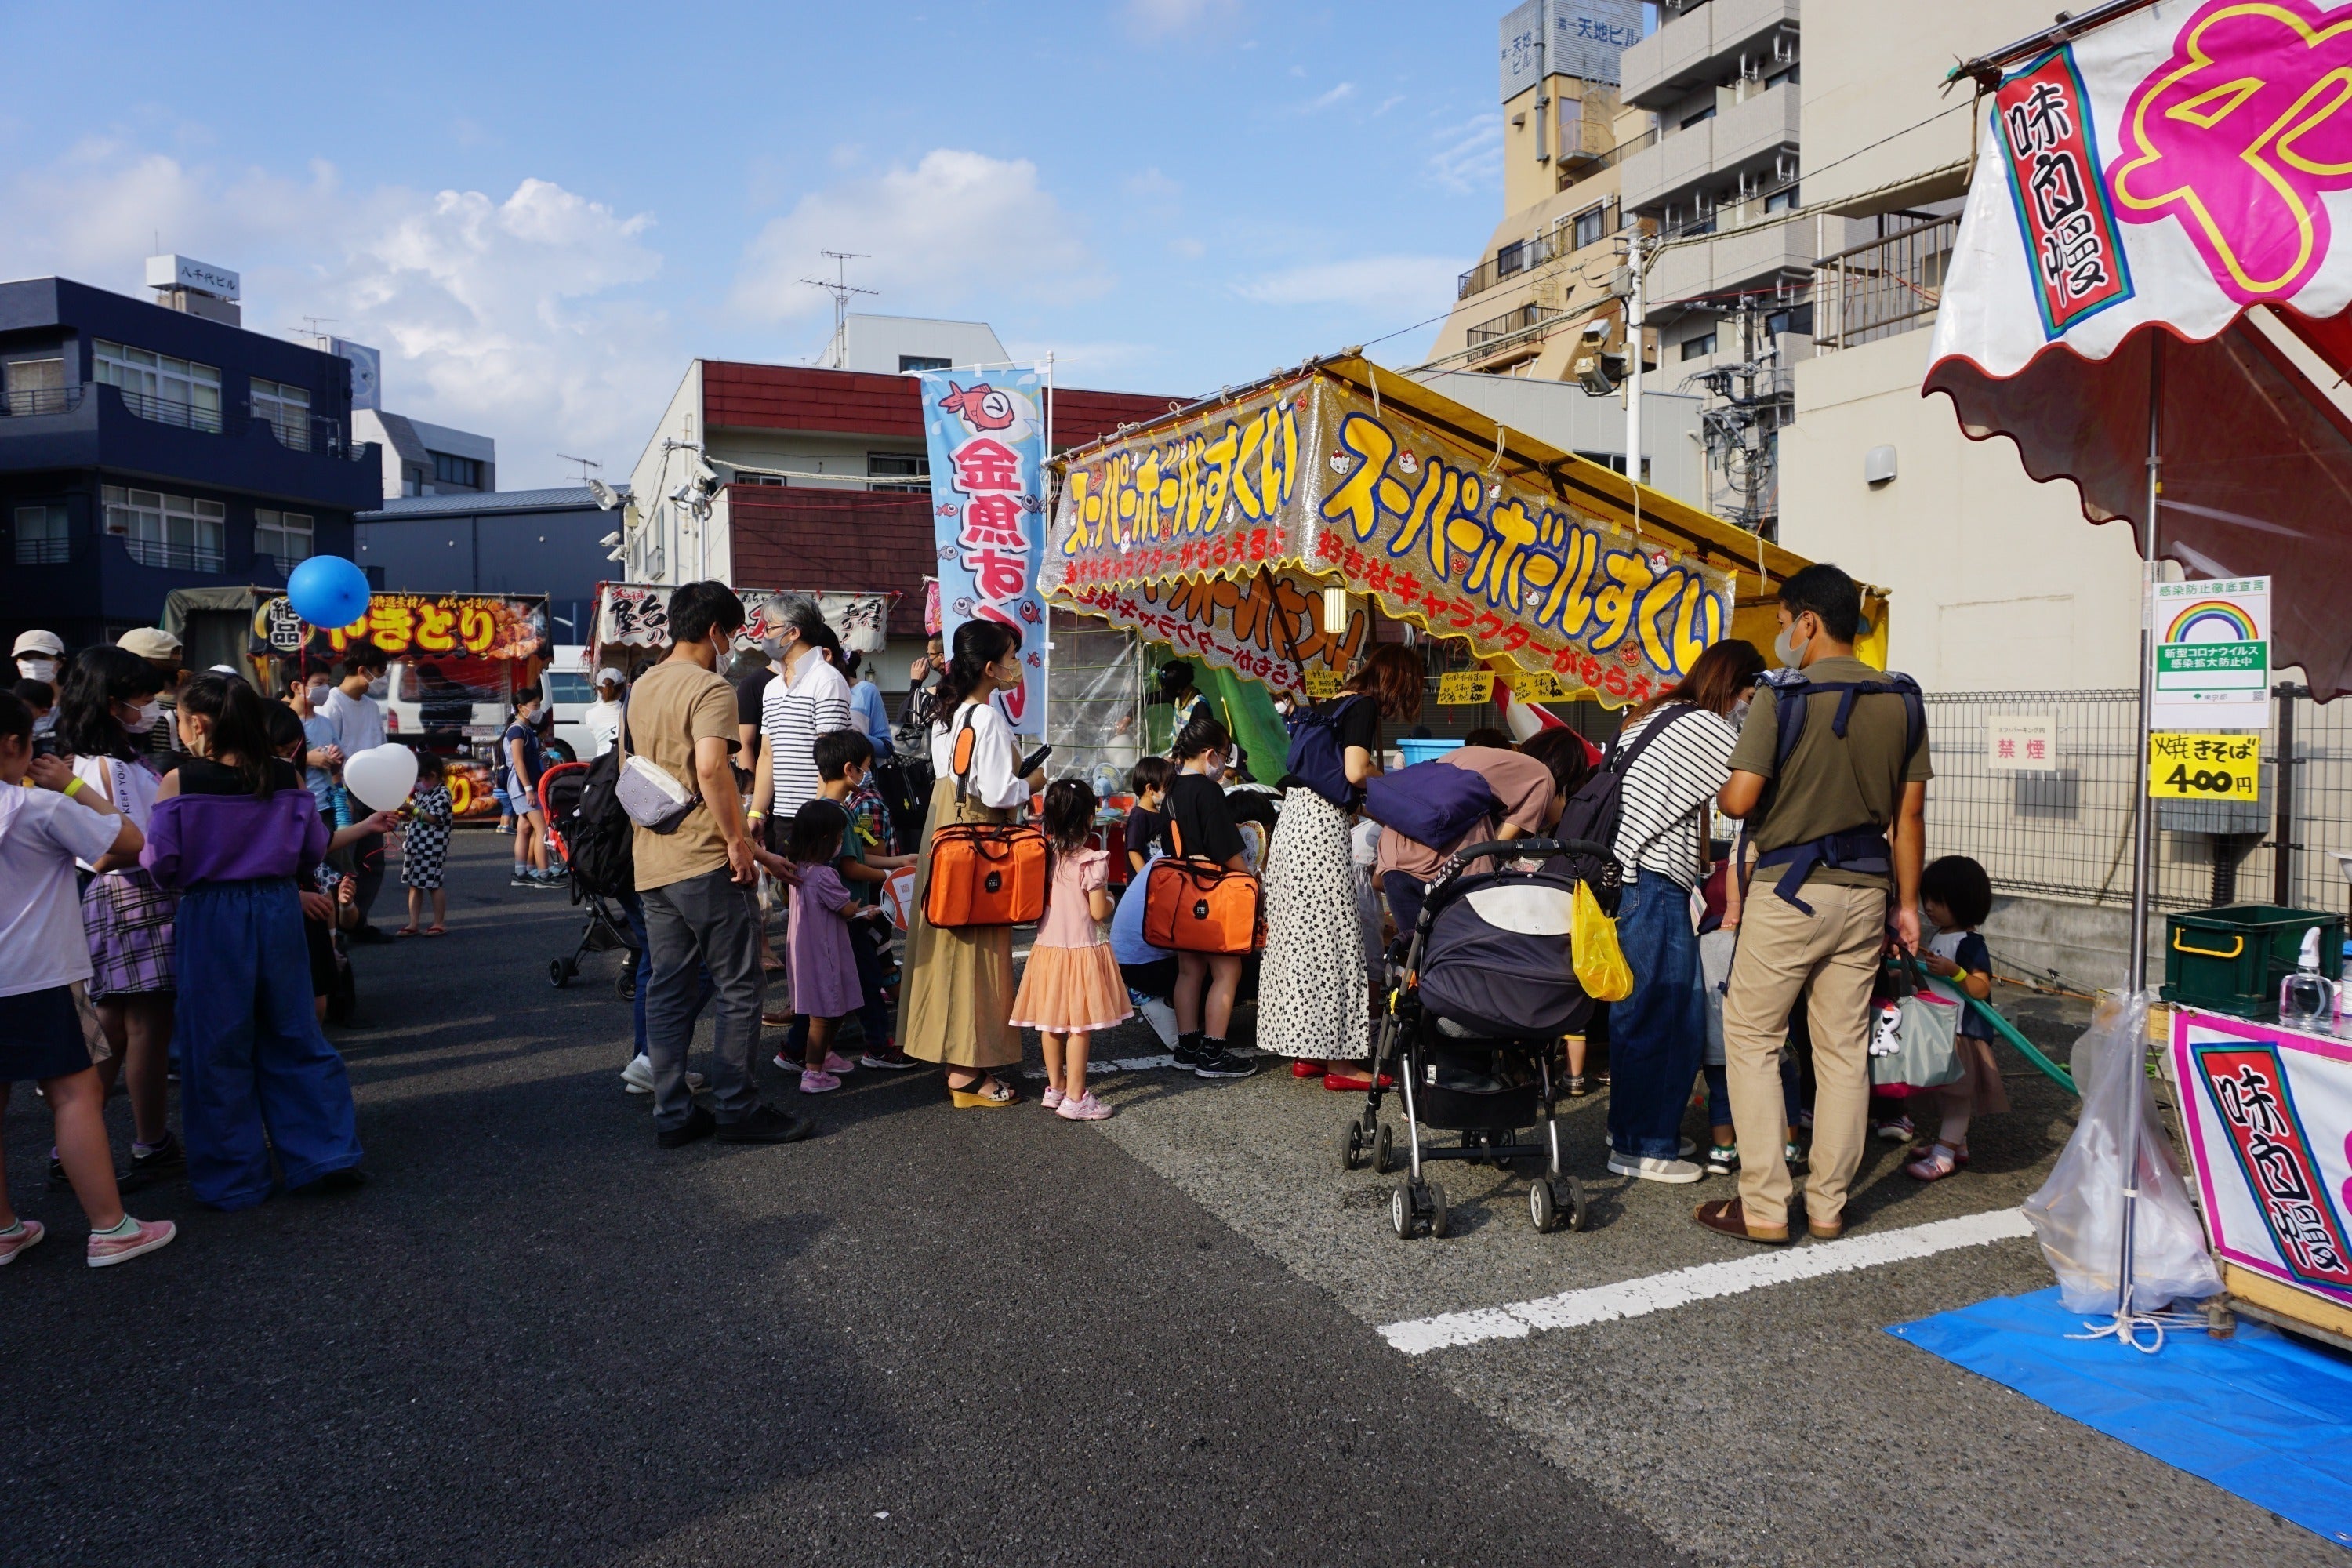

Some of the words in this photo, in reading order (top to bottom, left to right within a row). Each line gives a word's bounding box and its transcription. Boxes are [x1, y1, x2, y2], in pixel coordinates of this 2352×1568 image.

[2006, 84, 2107, 307] 味自慢
[181, 266, 235, 291] 八千代ビル
[1062, 404, 1300, 557] スーパーボールすくい
[1319, 412, 1723, 678] スーパーボールすくい
[2159, 579, 2265, 597] 感染防止徹底宣言
[270, 597, 302, 646] 絶品
[2164, 646, 2259, 659] 新型コロナウイルス
[2171, 657, 2252, 669] 感染拡大防止中
[2154, 734, 2257, 763] 焼きそば
[115, 761, 126, 786] YOUR
[2164, 763, 2252, 793] 400円
[120, 789, 131, 814] KEEP
[2214, 1065, 2347, 1274] 味自慢
